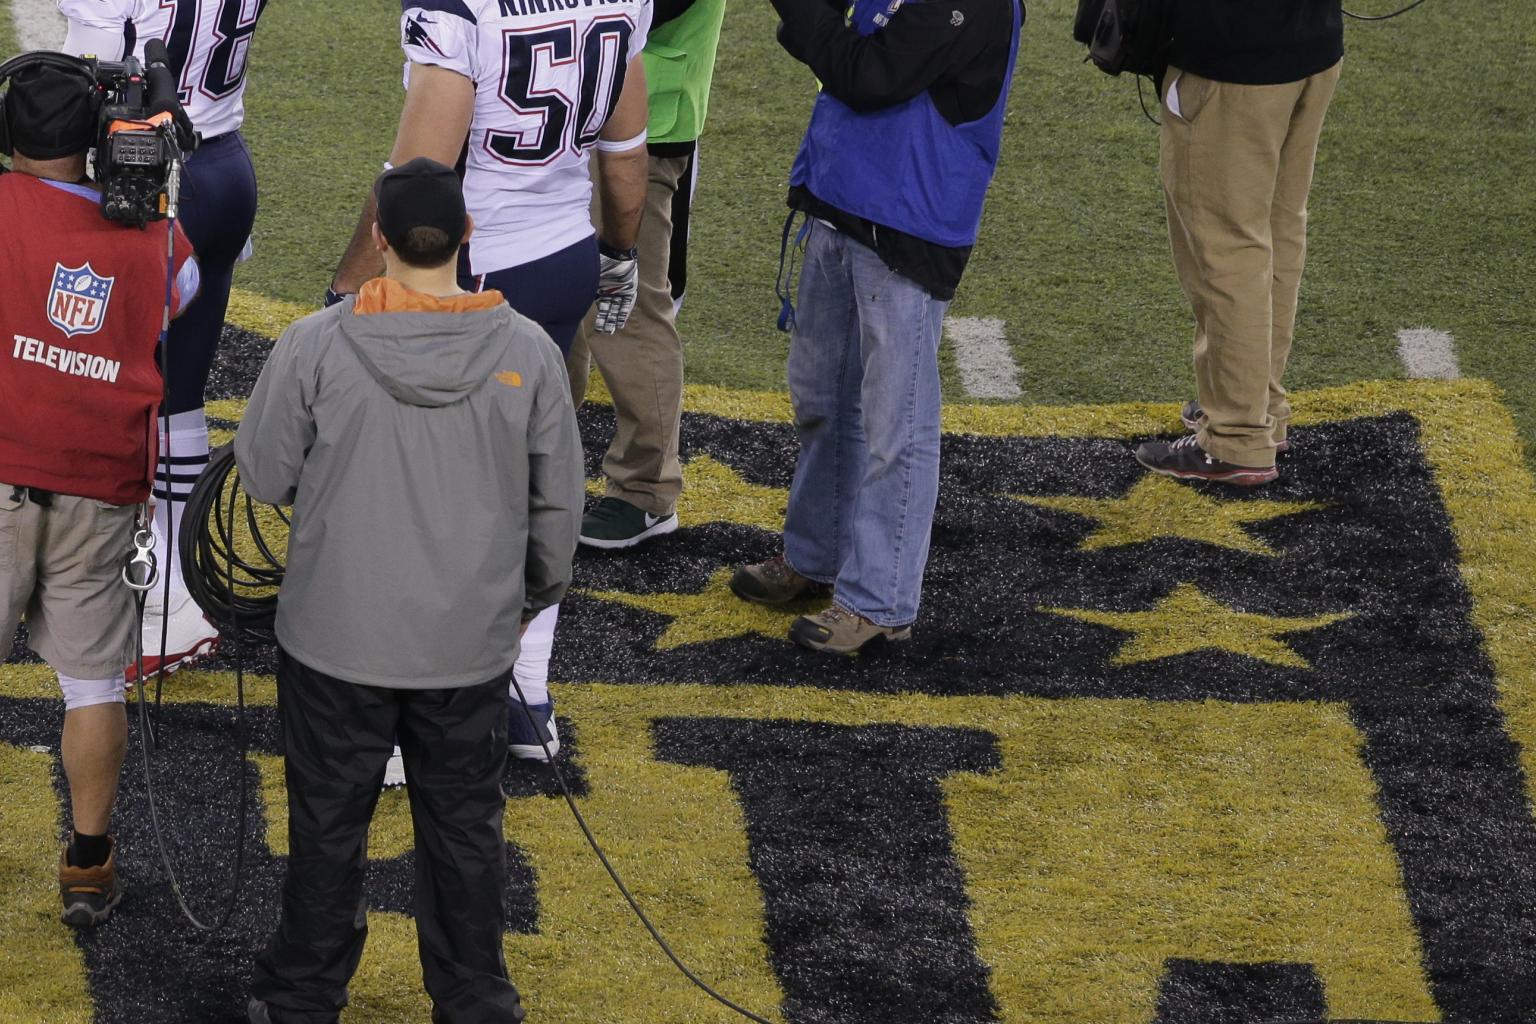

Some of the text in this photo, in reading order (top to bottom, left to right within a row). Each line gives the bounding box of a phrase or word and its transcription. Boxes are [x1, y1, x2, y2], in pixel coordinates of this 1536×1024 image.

[482, 13, 636, 167] 50
[52, 291, 97, 328] NFL
[12, 334, 121, 383] TELEVISION
